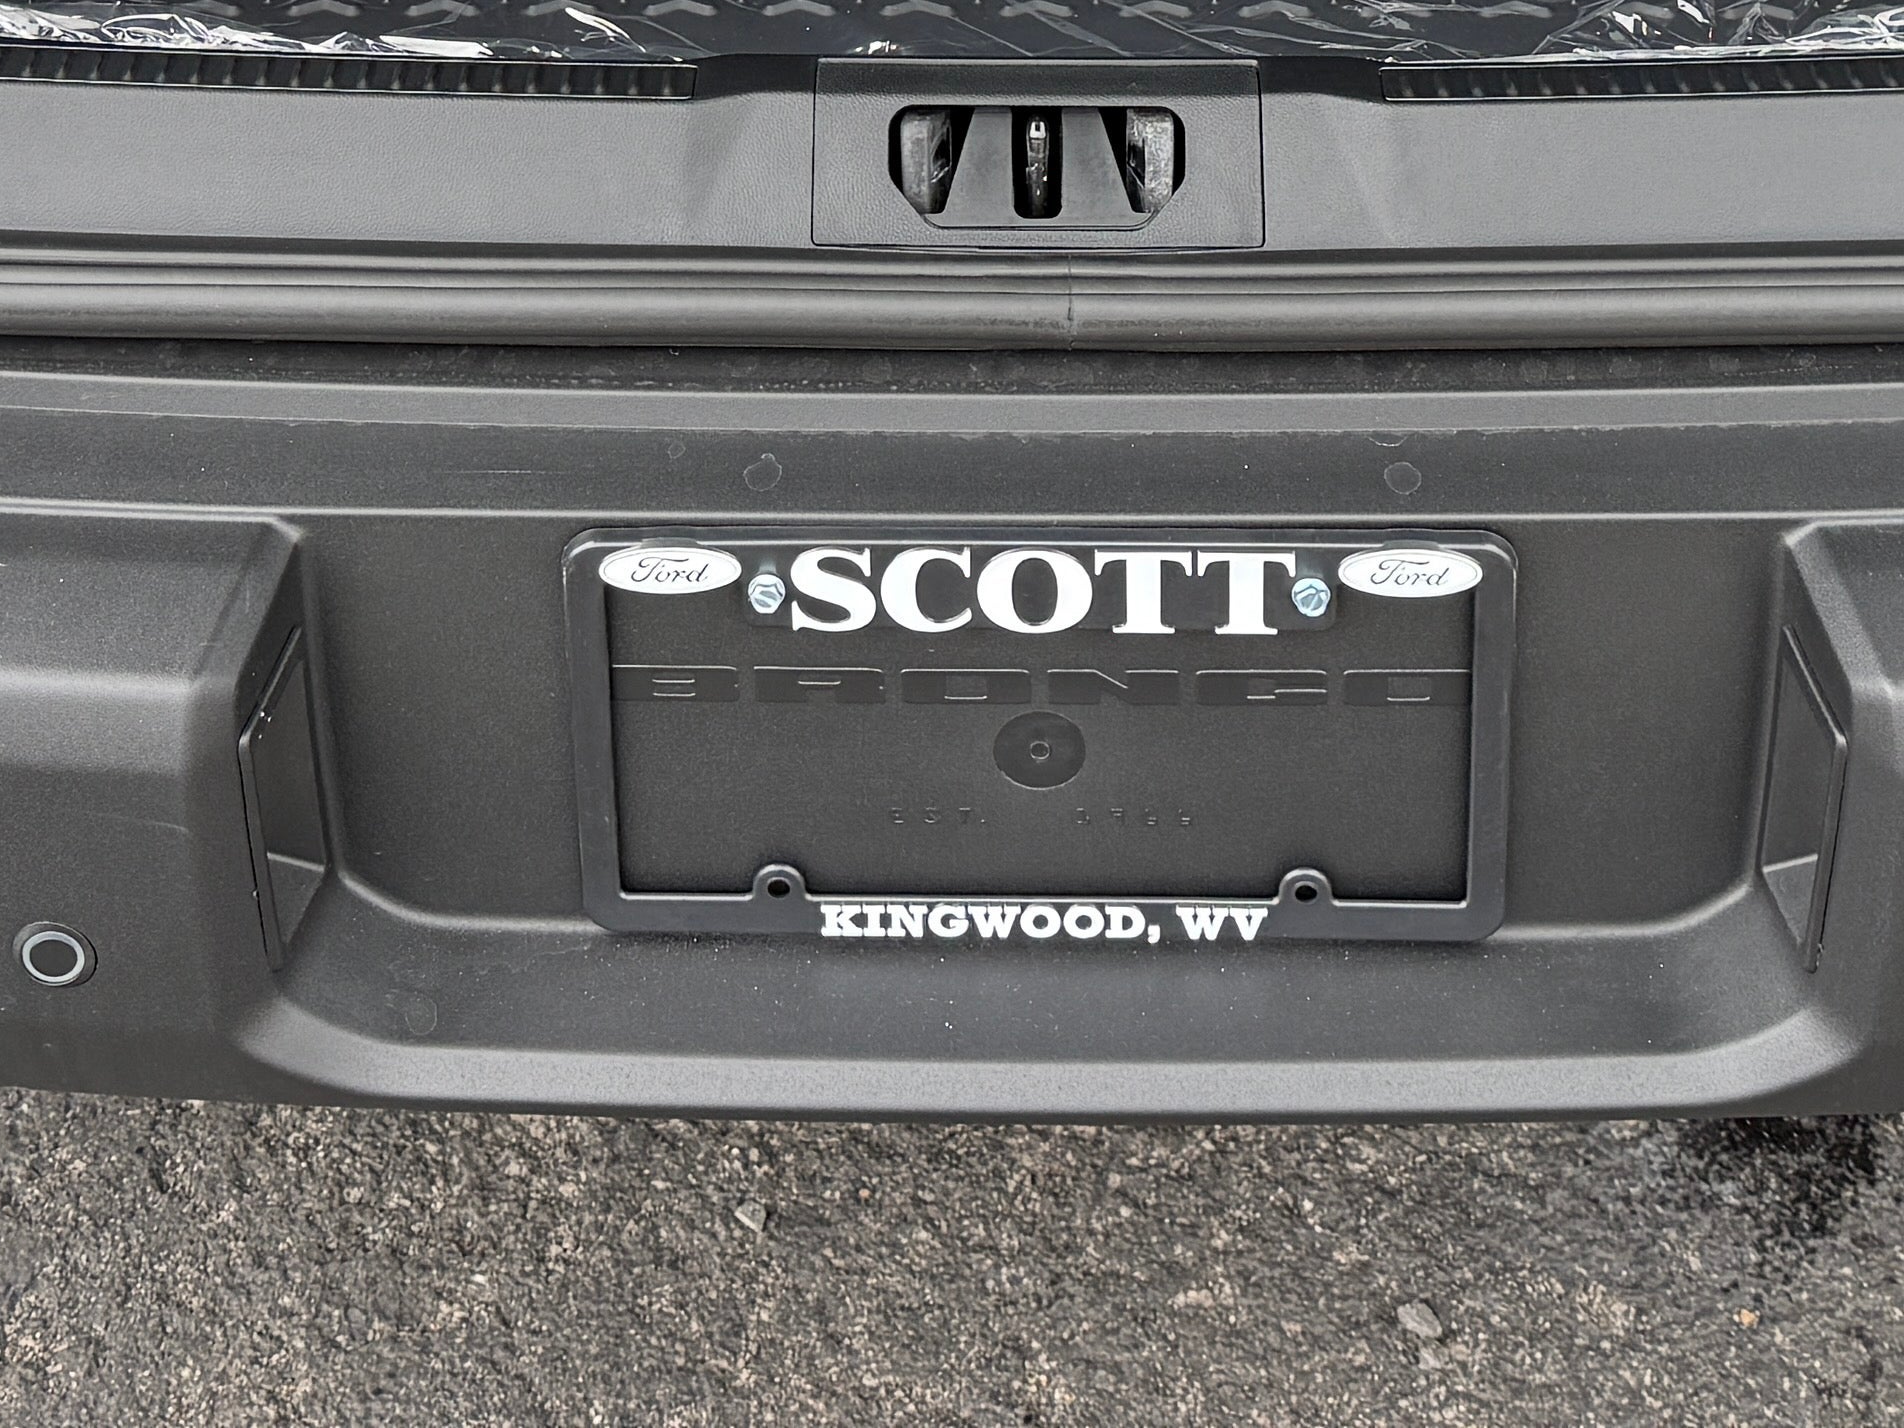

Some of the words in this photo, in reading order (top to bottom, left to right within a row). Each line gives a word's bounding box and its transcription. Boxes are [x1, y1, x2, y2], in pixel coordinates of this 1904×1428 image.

[630, 556, 710, 584] Ford
[1370, 558, 1451, 587] Ford
[791, 546, 1297, 636] SCOTT
[611, 664, 1471, 706] BRONCO
[820, 903, 1162, 943] KINGWOOD,
[1175, 904, 1270, 941] WV
